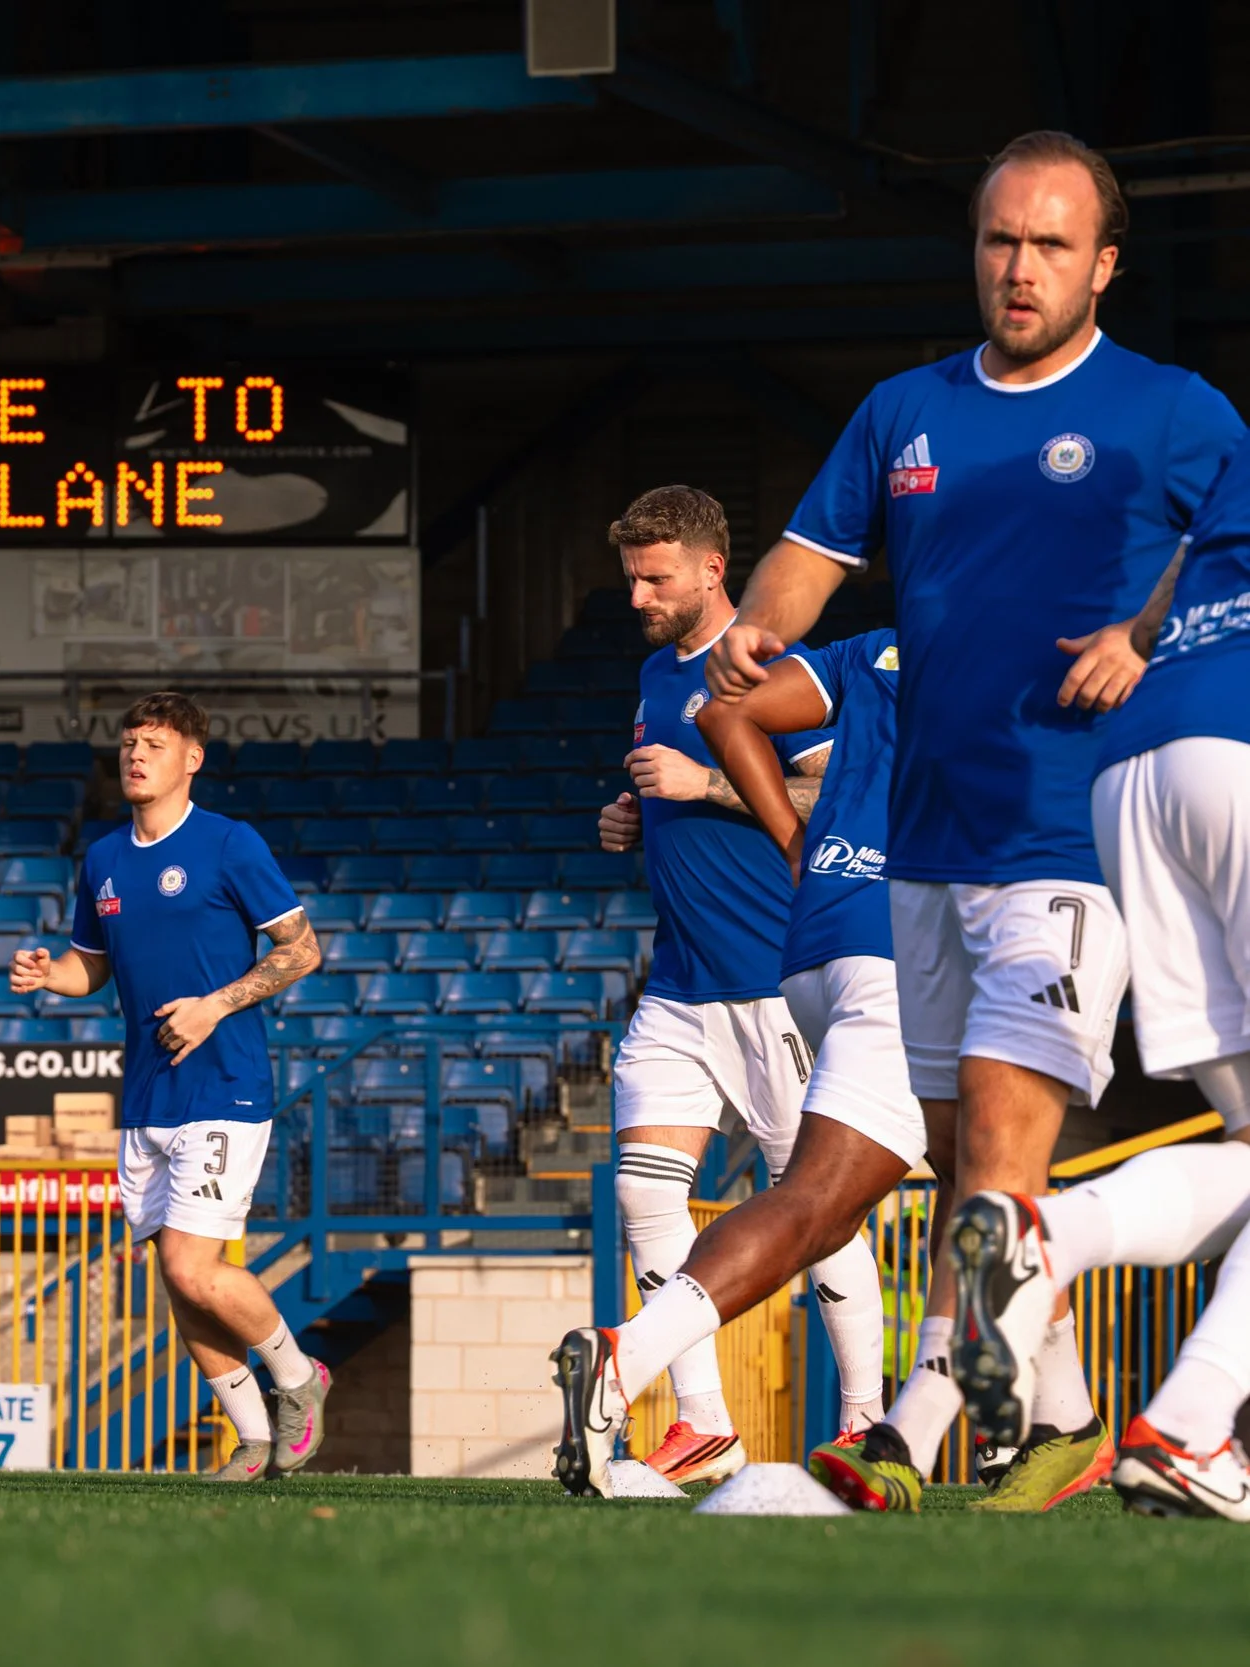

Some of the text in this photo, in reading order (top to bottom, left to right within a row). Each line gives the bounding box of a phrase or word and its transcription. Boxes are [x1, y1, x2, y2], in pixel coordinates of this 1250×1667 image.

[176, 376, 285, 442] TO
[1049, 896, 1086, 970] 7
[203, 1131, 229, 1176] 3
